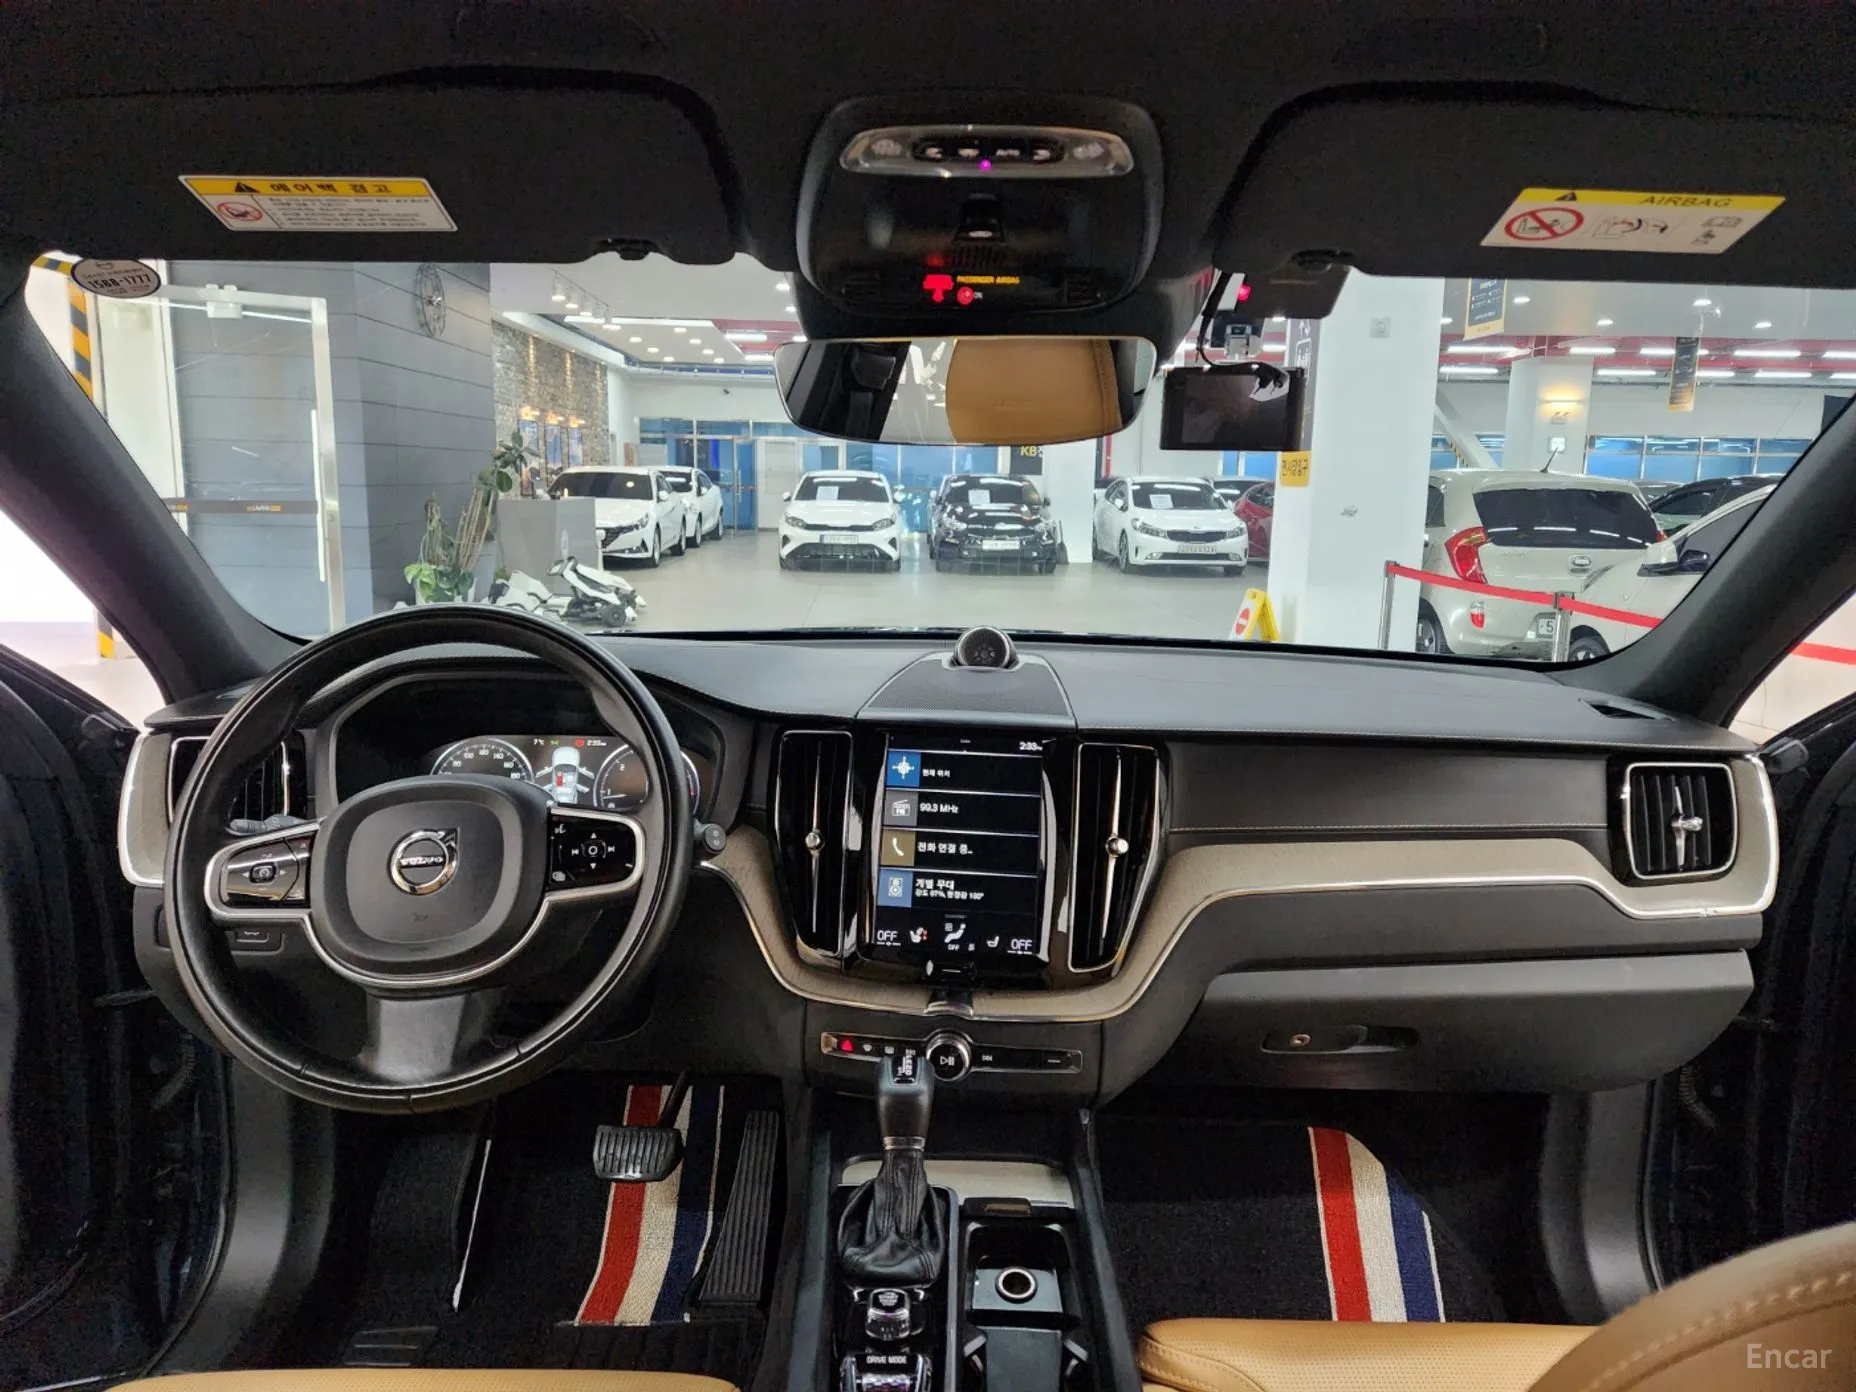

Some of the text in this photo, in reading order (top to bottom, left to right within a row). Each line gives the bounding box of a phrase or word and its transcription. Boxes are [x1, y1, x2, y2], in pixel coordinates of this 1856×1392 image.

[1640, 197, 1732, 207] AIRBAG
[88, 274, 152, 289] 1588-1777
[919, 803, 959, 814] 99.3 MHz
[400, 857, 444, 866] VOLVO
[877, 930, 898, 941] OFF
[1010, 939, 1033, 950] OFF
[867, 1355, 907, 1364] DRIVE MODE
